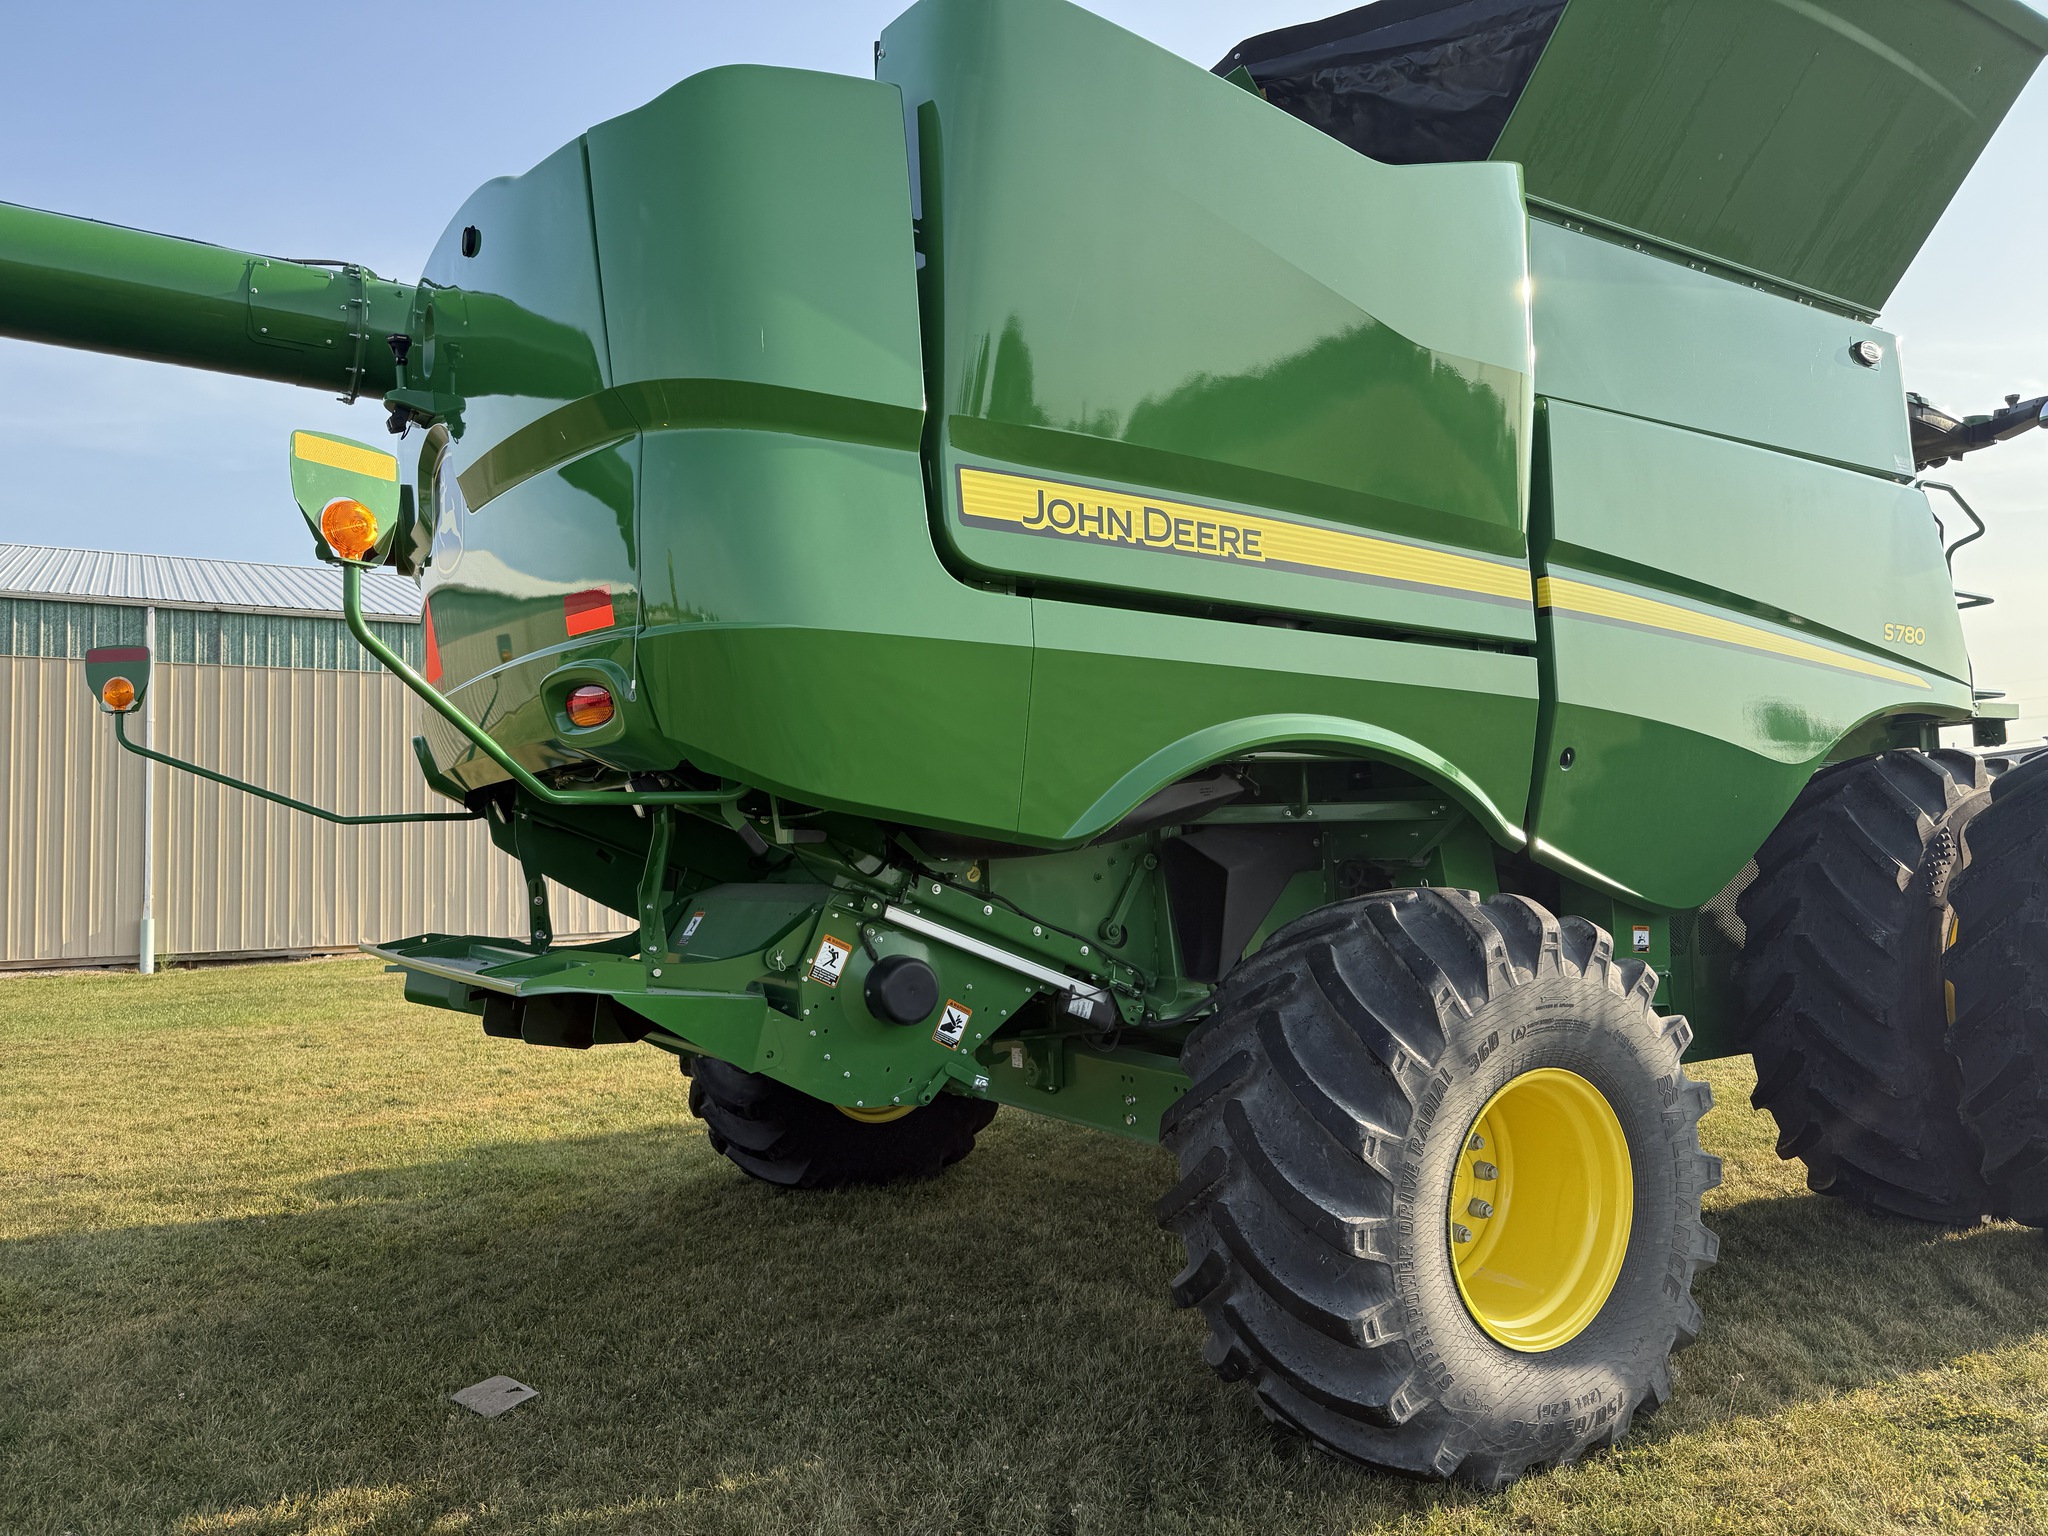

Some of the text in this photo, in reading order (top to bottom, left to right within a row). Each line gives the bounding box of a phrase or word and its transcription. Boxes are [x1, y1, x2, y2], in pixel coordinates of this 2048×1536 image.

[1023, 489, 1263, 558] JOHN DEERE
[1883, 622, 1926, 647] S780
[1398, 1030, 1500, 1393] SUPER POWER DRIVE RADIAL 360
[1660, 1108, 1694, 1303] ALLIANCE
